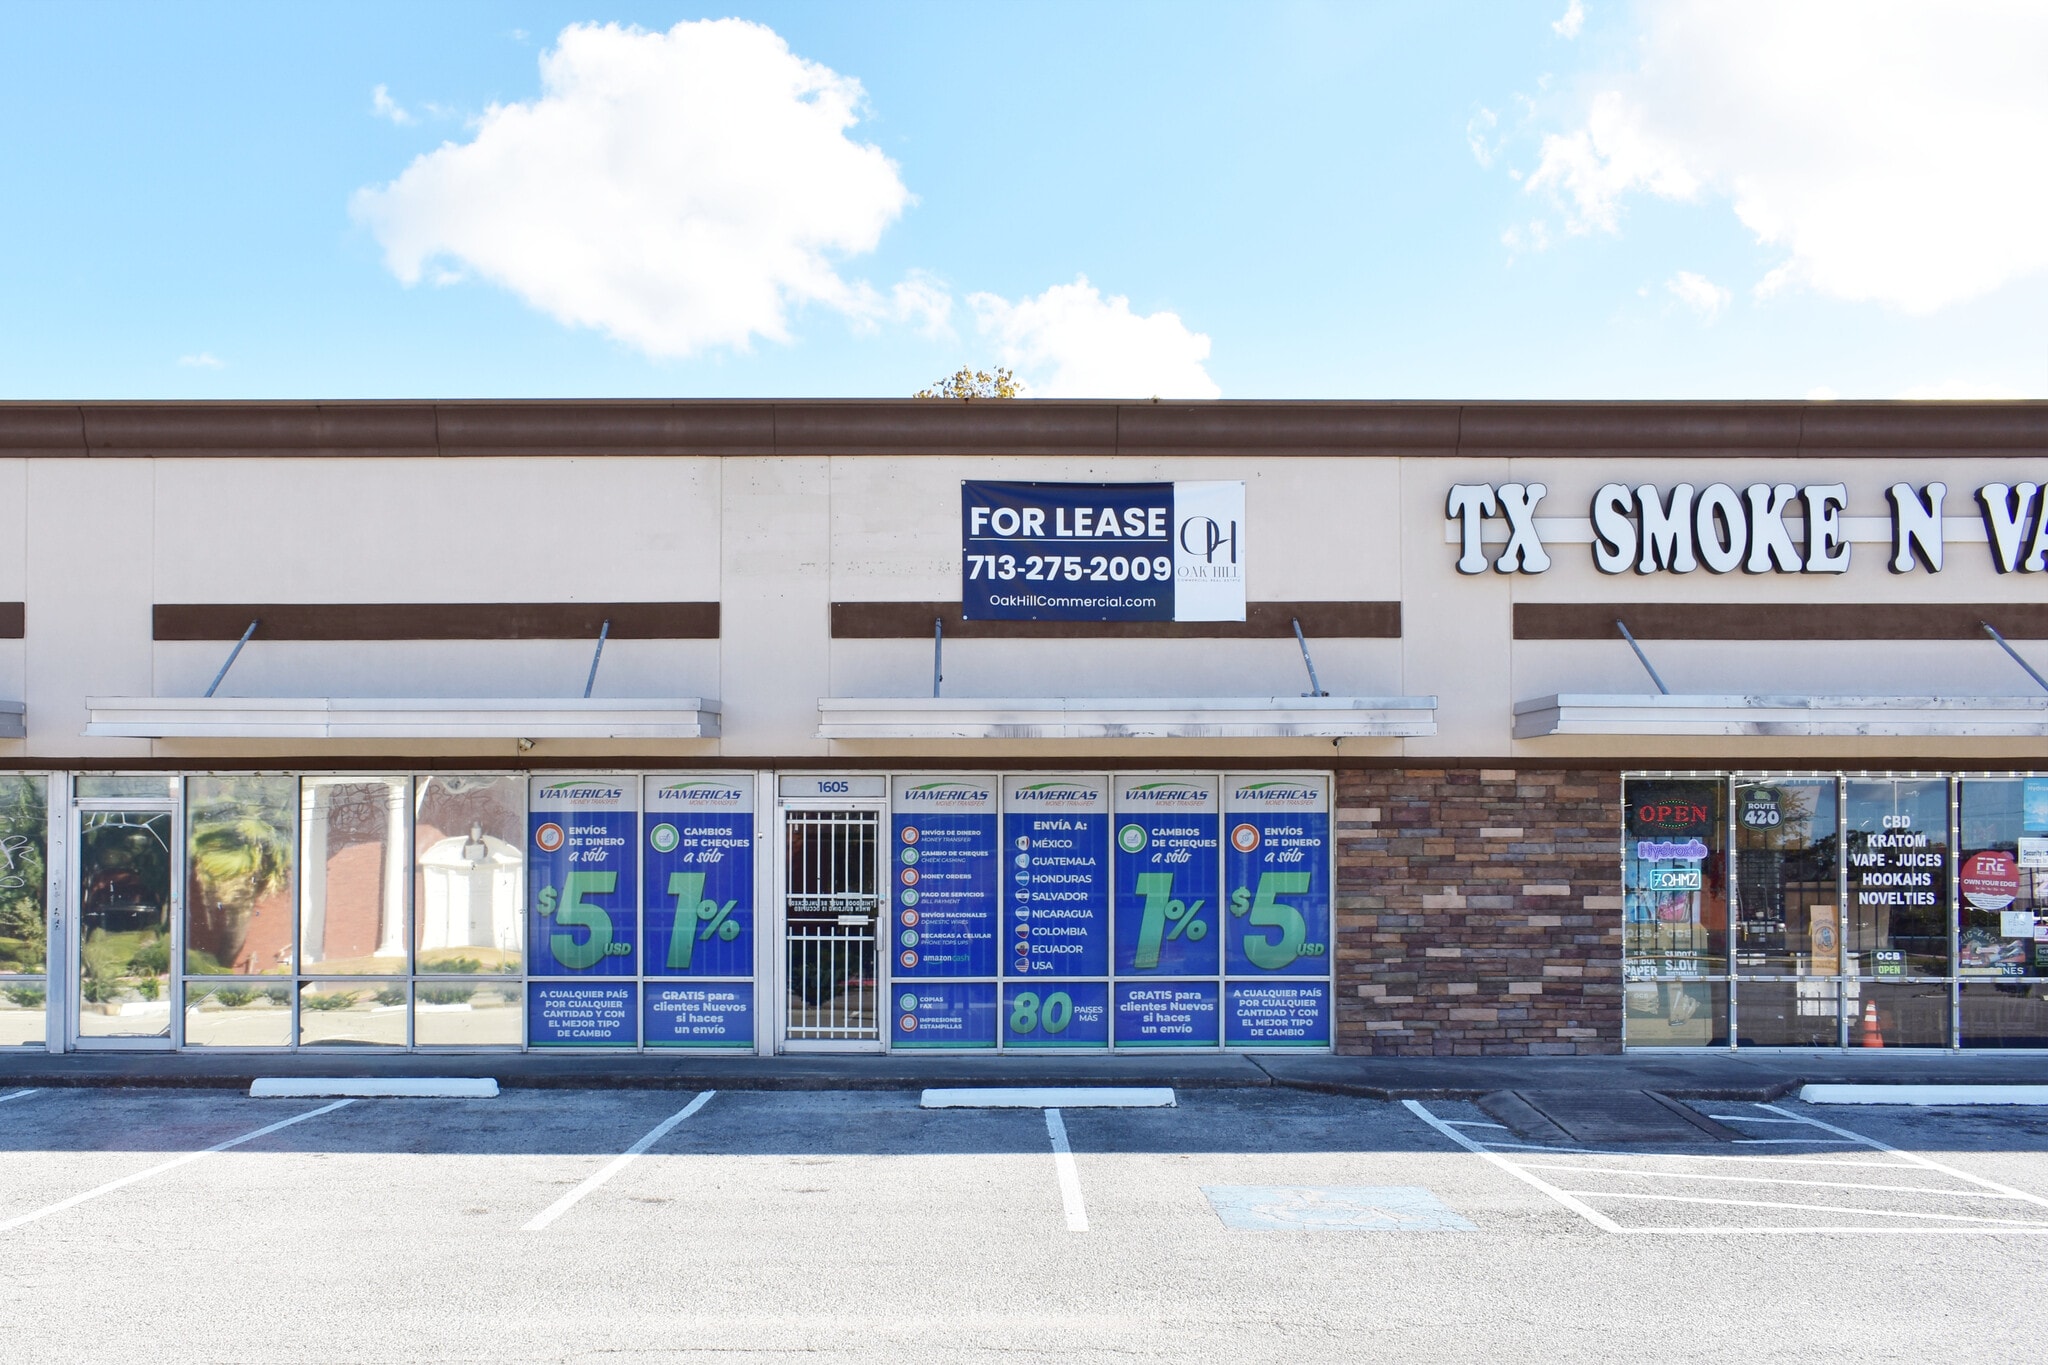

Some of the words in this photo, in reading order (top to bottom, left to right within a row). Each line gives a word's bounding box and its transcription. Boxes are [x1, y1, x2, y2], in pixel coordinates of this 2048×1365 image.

[971, 507, 1045, 536] FOR
[1056, 507, 1166, 537] LEASE
[1447, 482, 1551, 575] TX
[1591, 482, 1852, 575] SMOKE
[1886, 482, 1947, 575] N
[967, 555, 1171, 581] 713-275-2009
[1178, 566, 1207, 577] OAK
[1213, 566, 1240, 577] HILL
[990, 594, 1156, 607] OakHillCommercial.com
[818, 781, 848, 793] 1605
[539, 788, 622, 799] VIAMERICAS
[658, 788, 742, 800] VIAMERICAS
[905, 791, 989, 800] VIAMERICAS
[1015, 791, 1099, 800] VIAMERICAS
[1125, 790, 1208, 800] VIAMERICAS
[1235, 790, 1318, 800] VIAMERICAS
[1640, 805, 1707, 822] OPEN
[1745, 810, 1779, 824] 420
[1034, 819, 1071, 830] ENVÍA
[1074, 821, 1088, 830] A:
[1883, 815, 1911, 828] CBD
[569, 825, 607, 835] ENVÍOS
[684, 828, 732, 836] CAMBIOS
[1152, 828, 1200, 836] CAMBIOS
[1265, 825, 1303, 836] ENVÍOS
[569, 838, 583, 846] DE
[586, 838, 625, 846] DINERO
[684, 839, 698, 847] DE
[701, 839, 749, 849] CHEQUES
[1032, 838, 1073, 848] MÉXICO
[1152, 839, 1166, 847] DE
[1168, 839, 1217, 849] CHEQUES
[1265, 838, 1279, 847] DE
[1282, 838, 1321, 847] DINERO
[1867, 835, 1926, 847] KRATOM
[569, 852, 579, 862] a
[581, 847, 608, 862] sólo
[684, 852, 694, 863] a
[697, 848, 724, 863] sólo
[1152, 853, 1162, 863] a
[1165, 848, 1192, 863] sólo
[1265, 852, 1275, 863] a
[1277, 848, 1305, 863] sólo
[1032, 857, 1096, 865] GUATEMALA
[1852, 854, 1885, 866] VAPE
[1896, 854, 1942, 866] JUICES
[1977, 857, 2007, 871] FRE
[1032, 875, 1092, 883] HONDURAS
[1862, 873, 1931, 886] HOOKAHS
[1032, 892, 1088, 901] SALVADOR
[1859, 892, 1935, 905] NOVELTIES
[1032, 910, 1093, 918] NICARAGUA
[666, 872, 741, 968] 1%
[1134, 872, 1208, 968] 1%
[1032, 927, 1087, 936] COLOMBIA
[603, 942, 631, 955] USD
[1032, 945, 1083, 953] ECUADOR
[1296, 943, 1324, 956] USD
[1876, 952, 1899, 960] OCB
[1032, 962, 1053, 970] USA
[1878, 965, 1900, 974] OPEN
[550, 991, 604, 999] CUALQUIER
[607, 989, 628, 998] PAÍS
[662, 991, 705, 1000] GRATIS
[708, 993, 734, 1002] para
[1129, 991, 1172, 1000] GRATIS
[1175, 992, 1201, 1002] para
[1243, 990, 1298, 998] CUALQUIER
[1300, 988, 1322, 997] PAÍS
[568, 1001, 623, 1009] CUALQUIER
[653, 1002, 700, 1011] clientes
[703, 1003, 746, 1011] Nuevos
[1120, 1002, 1167, 1011] clientes
[1170, 1002, 1214, 1011] Nuevos
[1239, 999, 1259, 1007] POR
[1262, 999, 1316, 1008] CUALQUIER
[543, 1010, 593, 1018] CANTIDAD
[604, 1010, 625, 1018] CON
[676, 1014, 686, 1022] si
[688, 1014, 723, 1022] haces
[1010, 992, 1073, 1034] 80
[1143, 1013, 1153, 1022] si
[1156, 1013, 1191, 1022] haces
[691, 1025, 725, 1034] envío
[1159, 1024, 1192, 1033] envío
